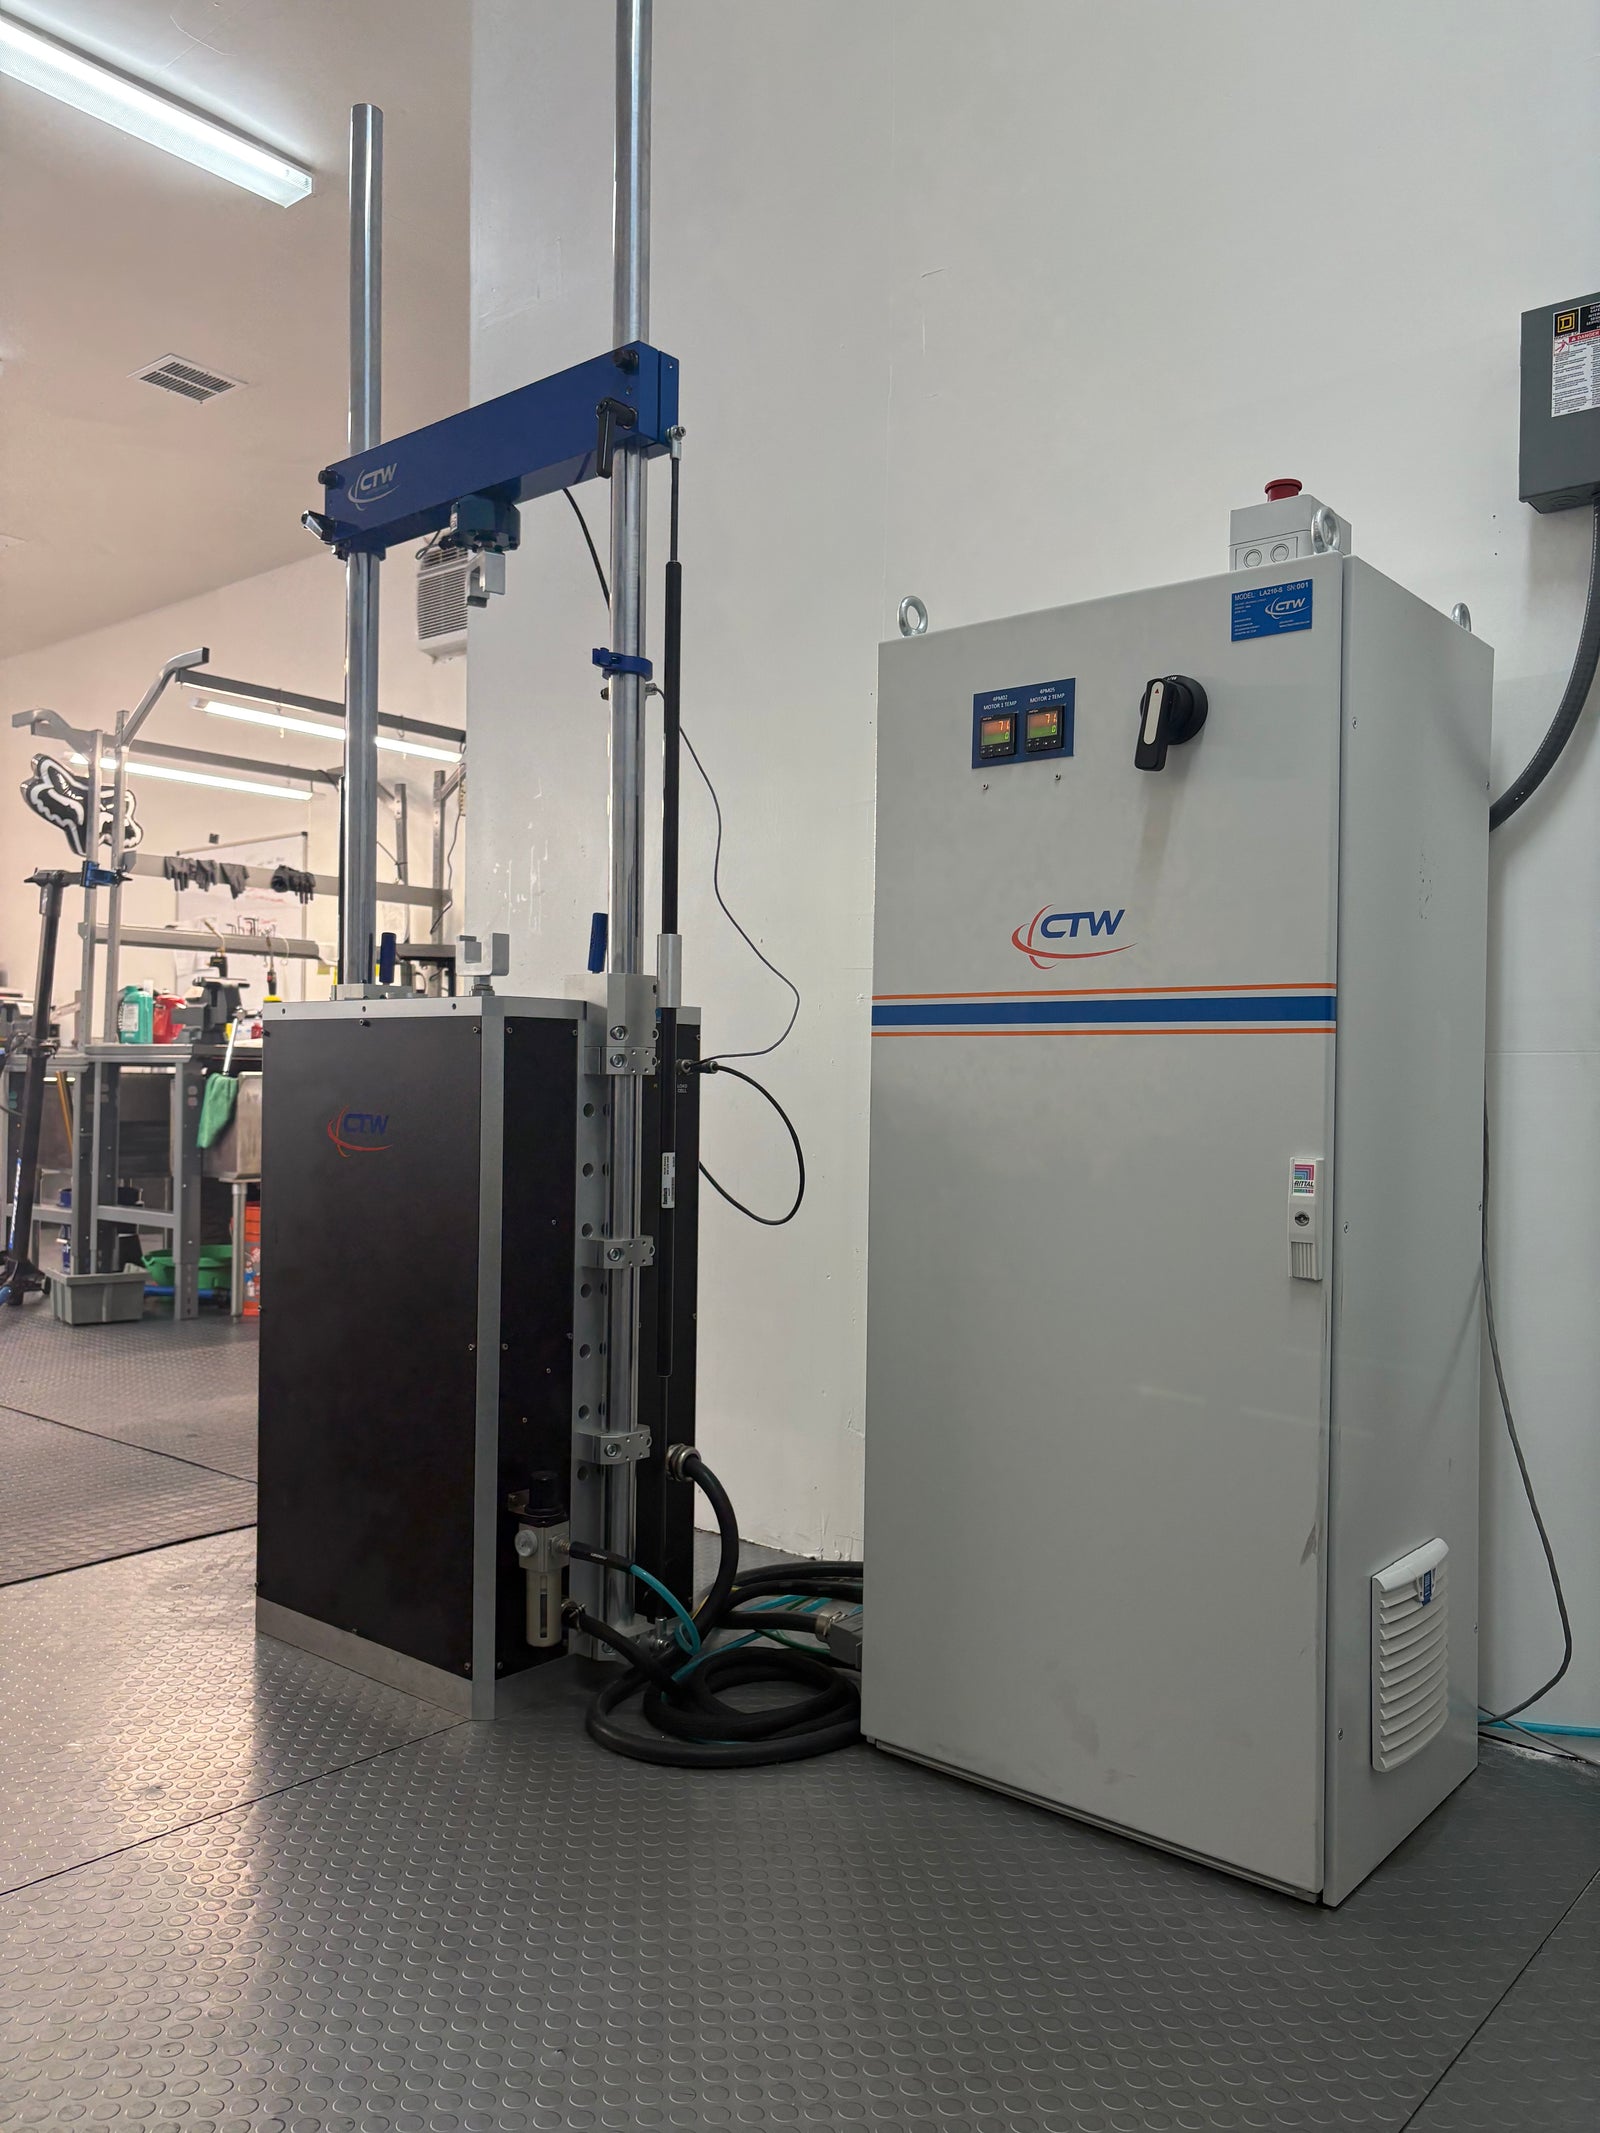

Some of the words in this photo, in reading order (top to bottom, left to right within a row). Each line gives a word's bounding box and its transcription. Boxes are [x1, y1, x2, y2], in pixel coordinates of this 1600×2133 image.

[1577, 330, 1600, 340] DANGER
[360, 462, 398, 491] CTW
[1275, 597, 1306, 611] CTW
[1040, 909, 1126, 939] CTW
[343, 1113, 390, 1136] CTW
